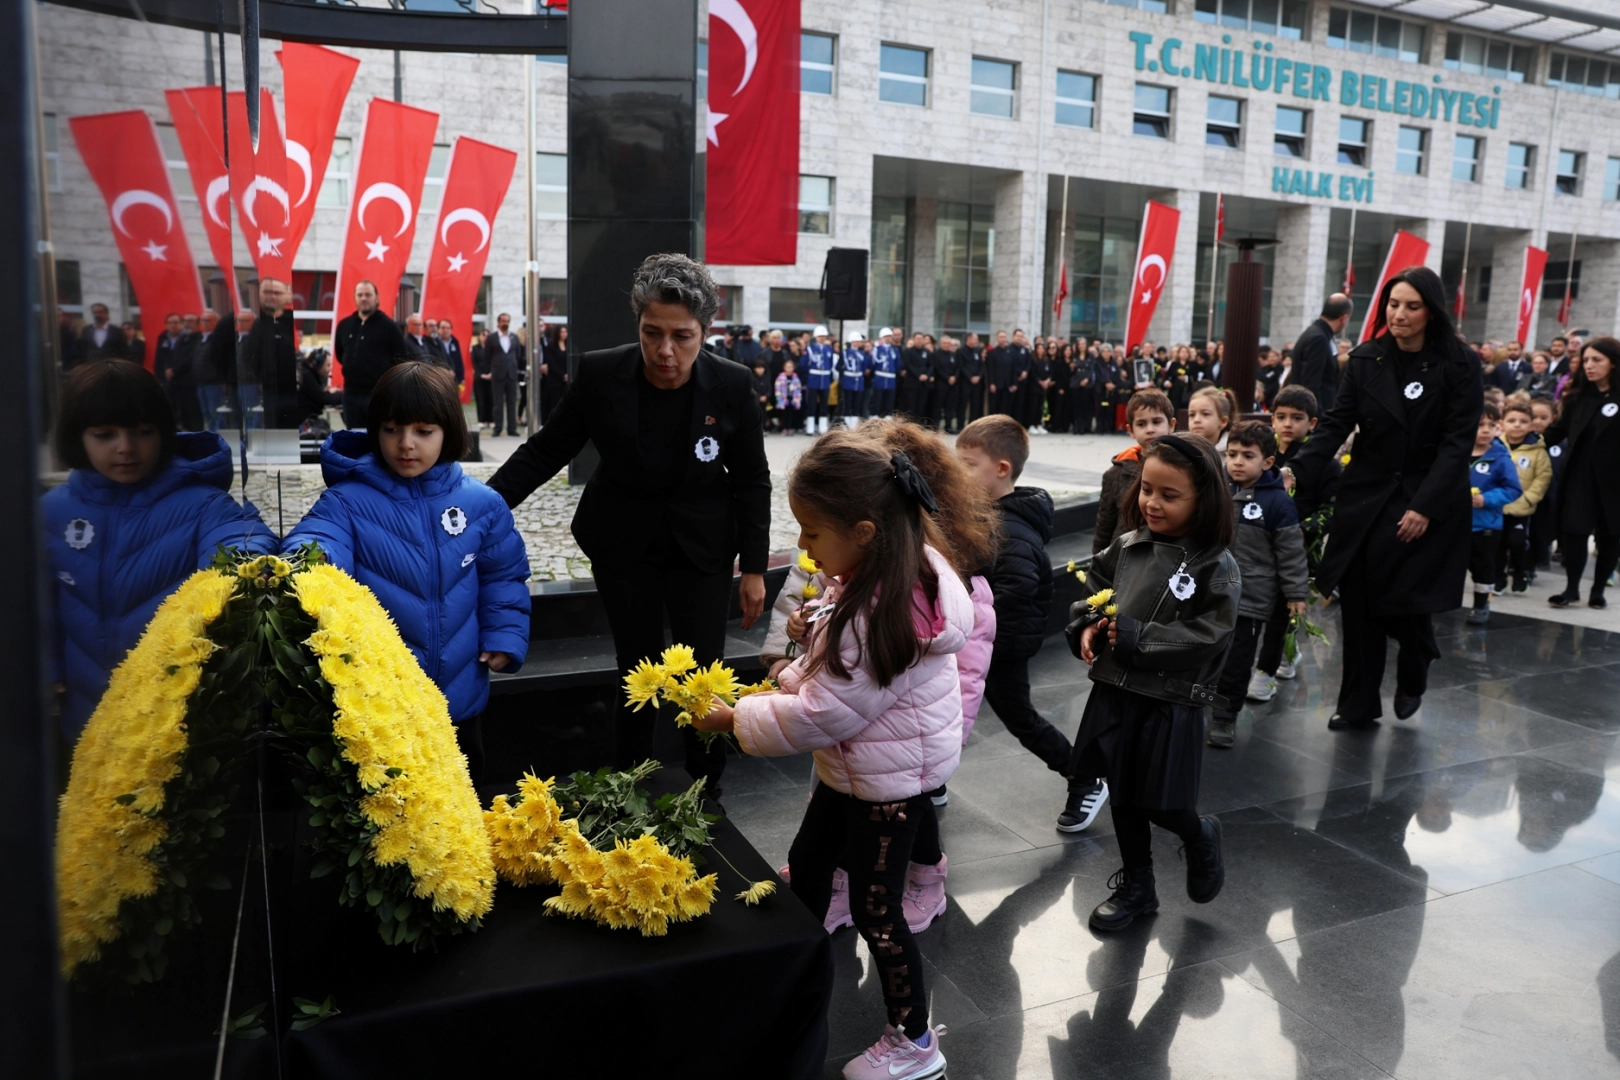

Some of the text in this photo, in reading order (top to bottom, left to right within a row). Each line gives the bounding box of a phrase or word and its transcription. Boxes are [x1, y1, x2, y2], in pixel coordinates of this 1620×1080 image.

[1340, 70, 1502, 129] BELEDİYESİ
[1272, 166, 1375, 204] HALK EVİ
